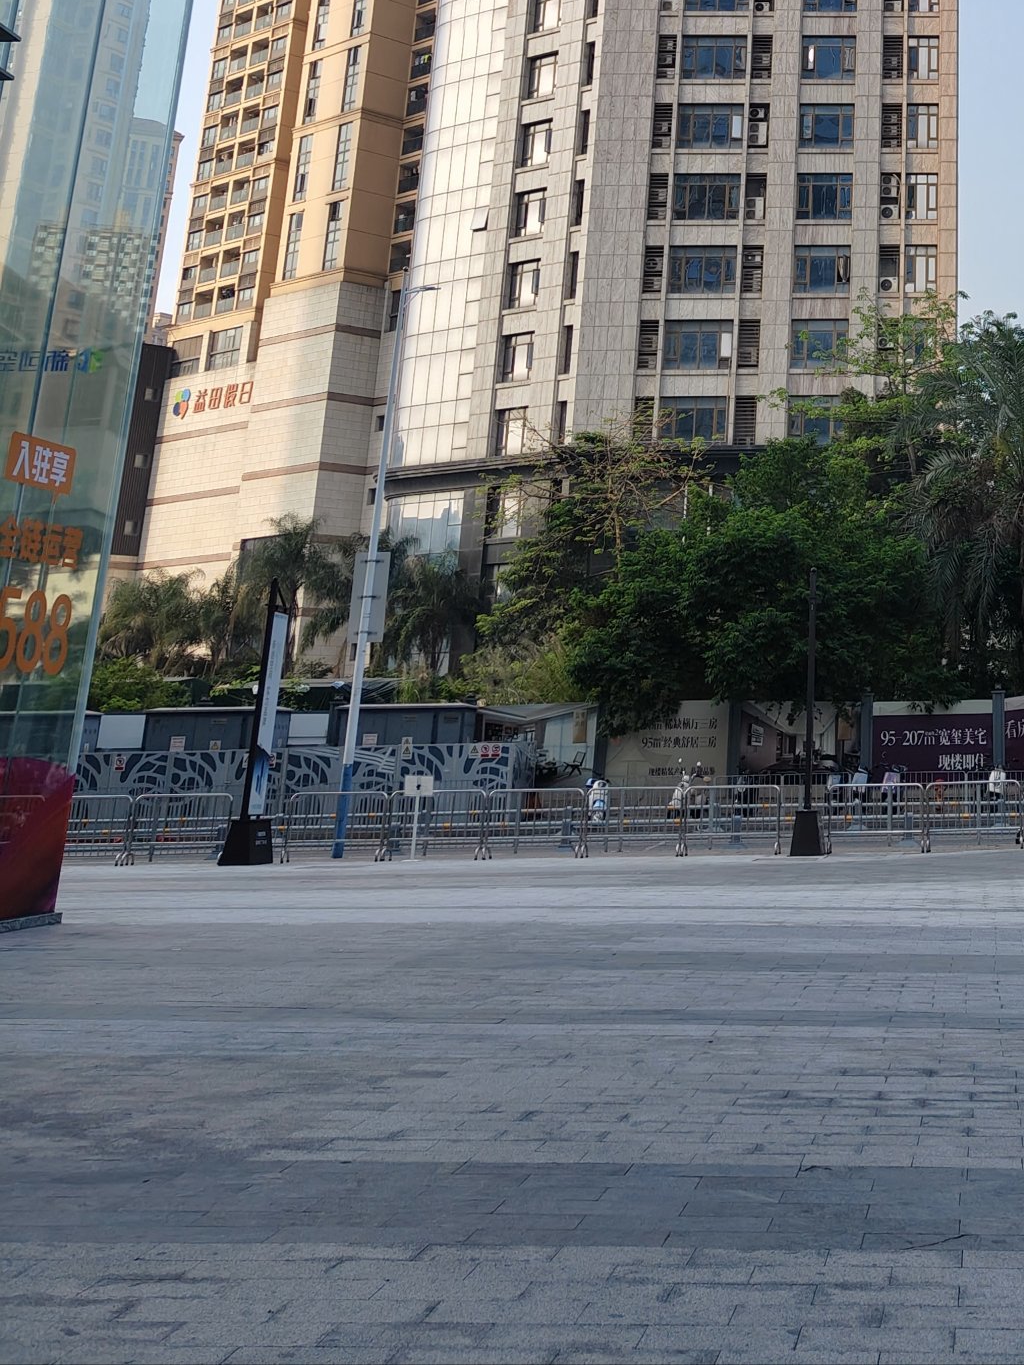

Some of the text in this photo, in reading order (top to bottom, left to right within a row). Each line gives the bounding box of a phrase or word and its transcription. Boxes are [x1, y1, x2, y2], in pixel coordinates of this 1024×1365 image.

[192, 381, 254, 414] 益田假日
[12, 440, 71, 487] 入驻享
